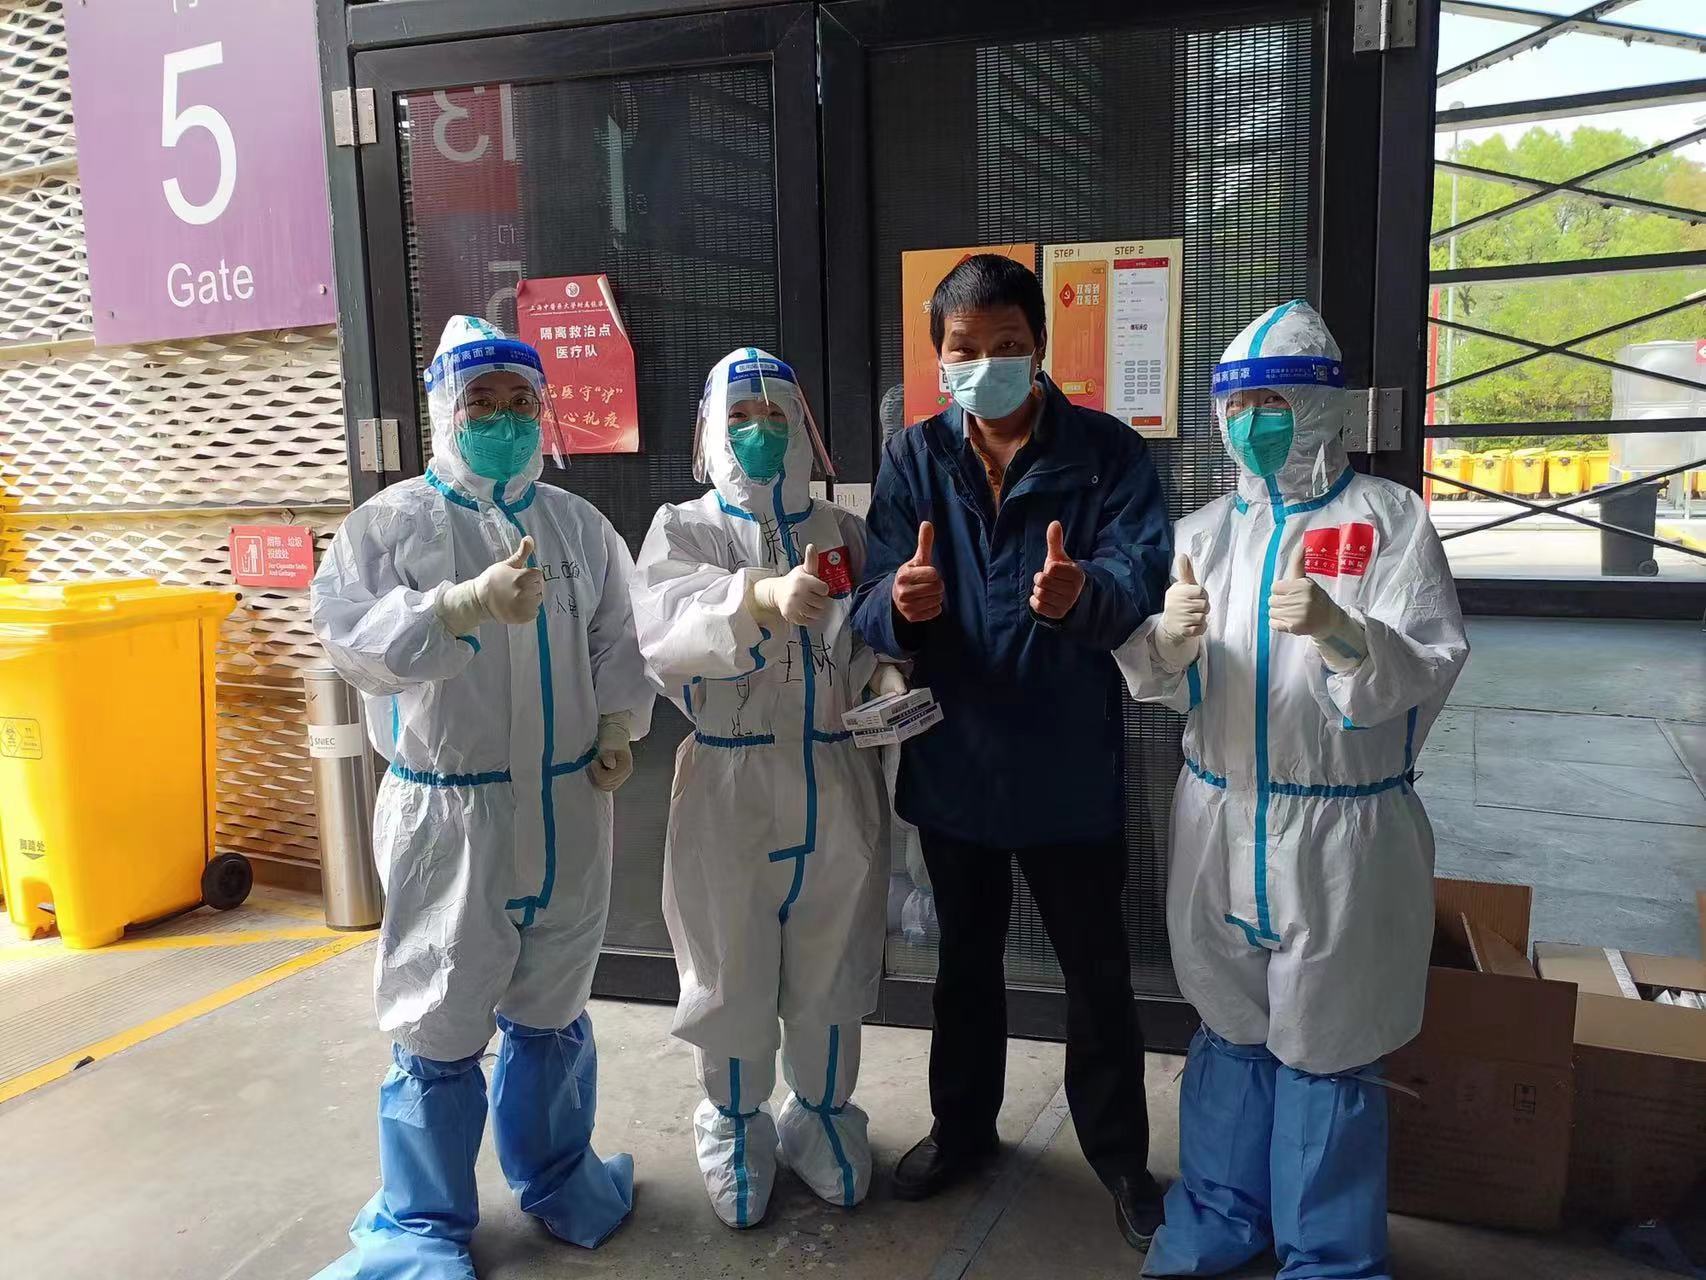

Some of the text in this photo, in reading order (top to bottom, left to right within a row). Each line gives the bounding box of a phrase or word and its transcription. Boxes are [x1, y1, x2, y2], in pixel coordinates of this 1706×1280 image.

[161, 41, 237, 225] 5
[1054, 249, 1074, 258] STEP
[1114, 245, 1144, 255] STEP 2
[167, 258, 255, 308] Gate
[540, 323, 612, 341] 隔离救治点
[555, 344, 599, 360] 医疗队
